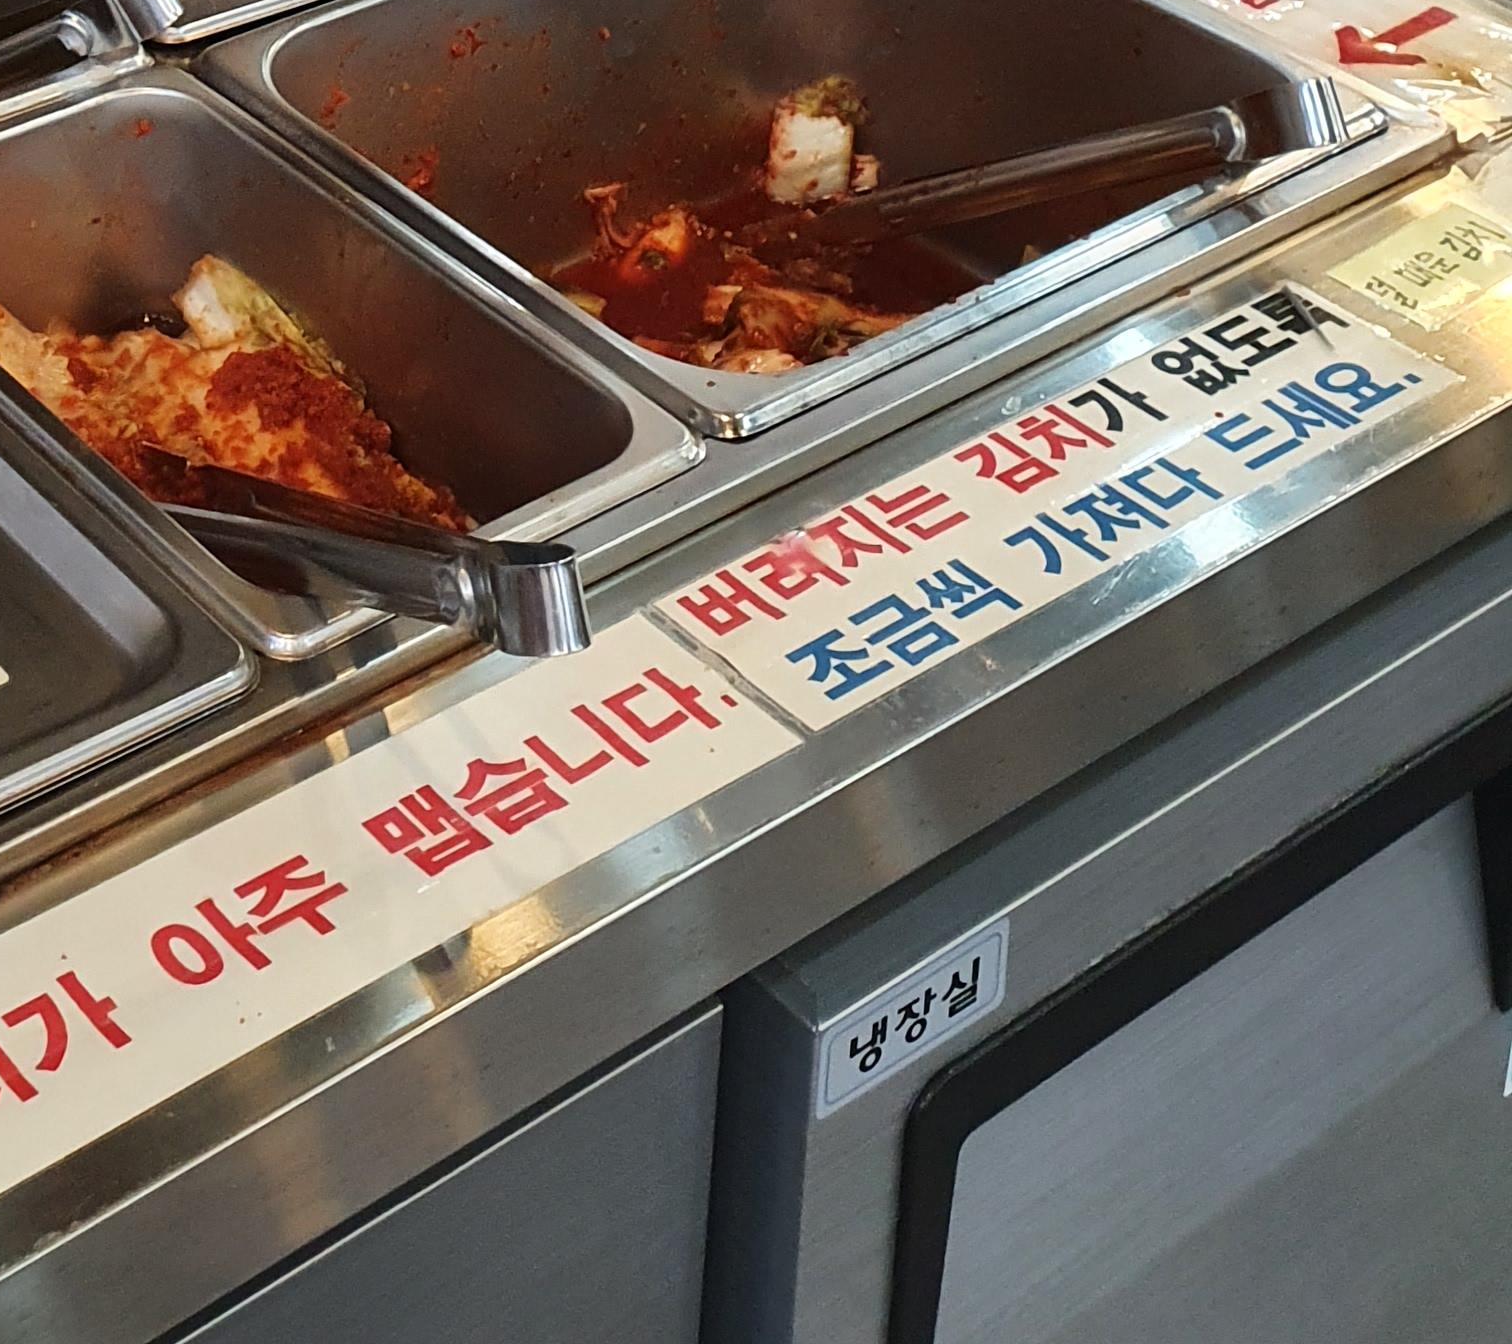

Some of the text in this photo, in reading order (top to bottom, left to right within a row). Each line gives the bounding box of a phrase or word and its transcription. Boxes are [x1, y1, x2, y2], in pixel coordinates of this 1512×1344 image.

[1364, 276, 1419, 310] 덜
[1439, 220, 1507, 262] 김치
[676, 290, 1351, 637] 버려지는 김치가 없도록
[785, 360, 1424, 702] 조금씩 가져다 드세요.
[149, 853, 351, 986] 아주
[361, 666, 738, 878] 맵습니다.
[848, 954, 982, 1074] 냉장실
